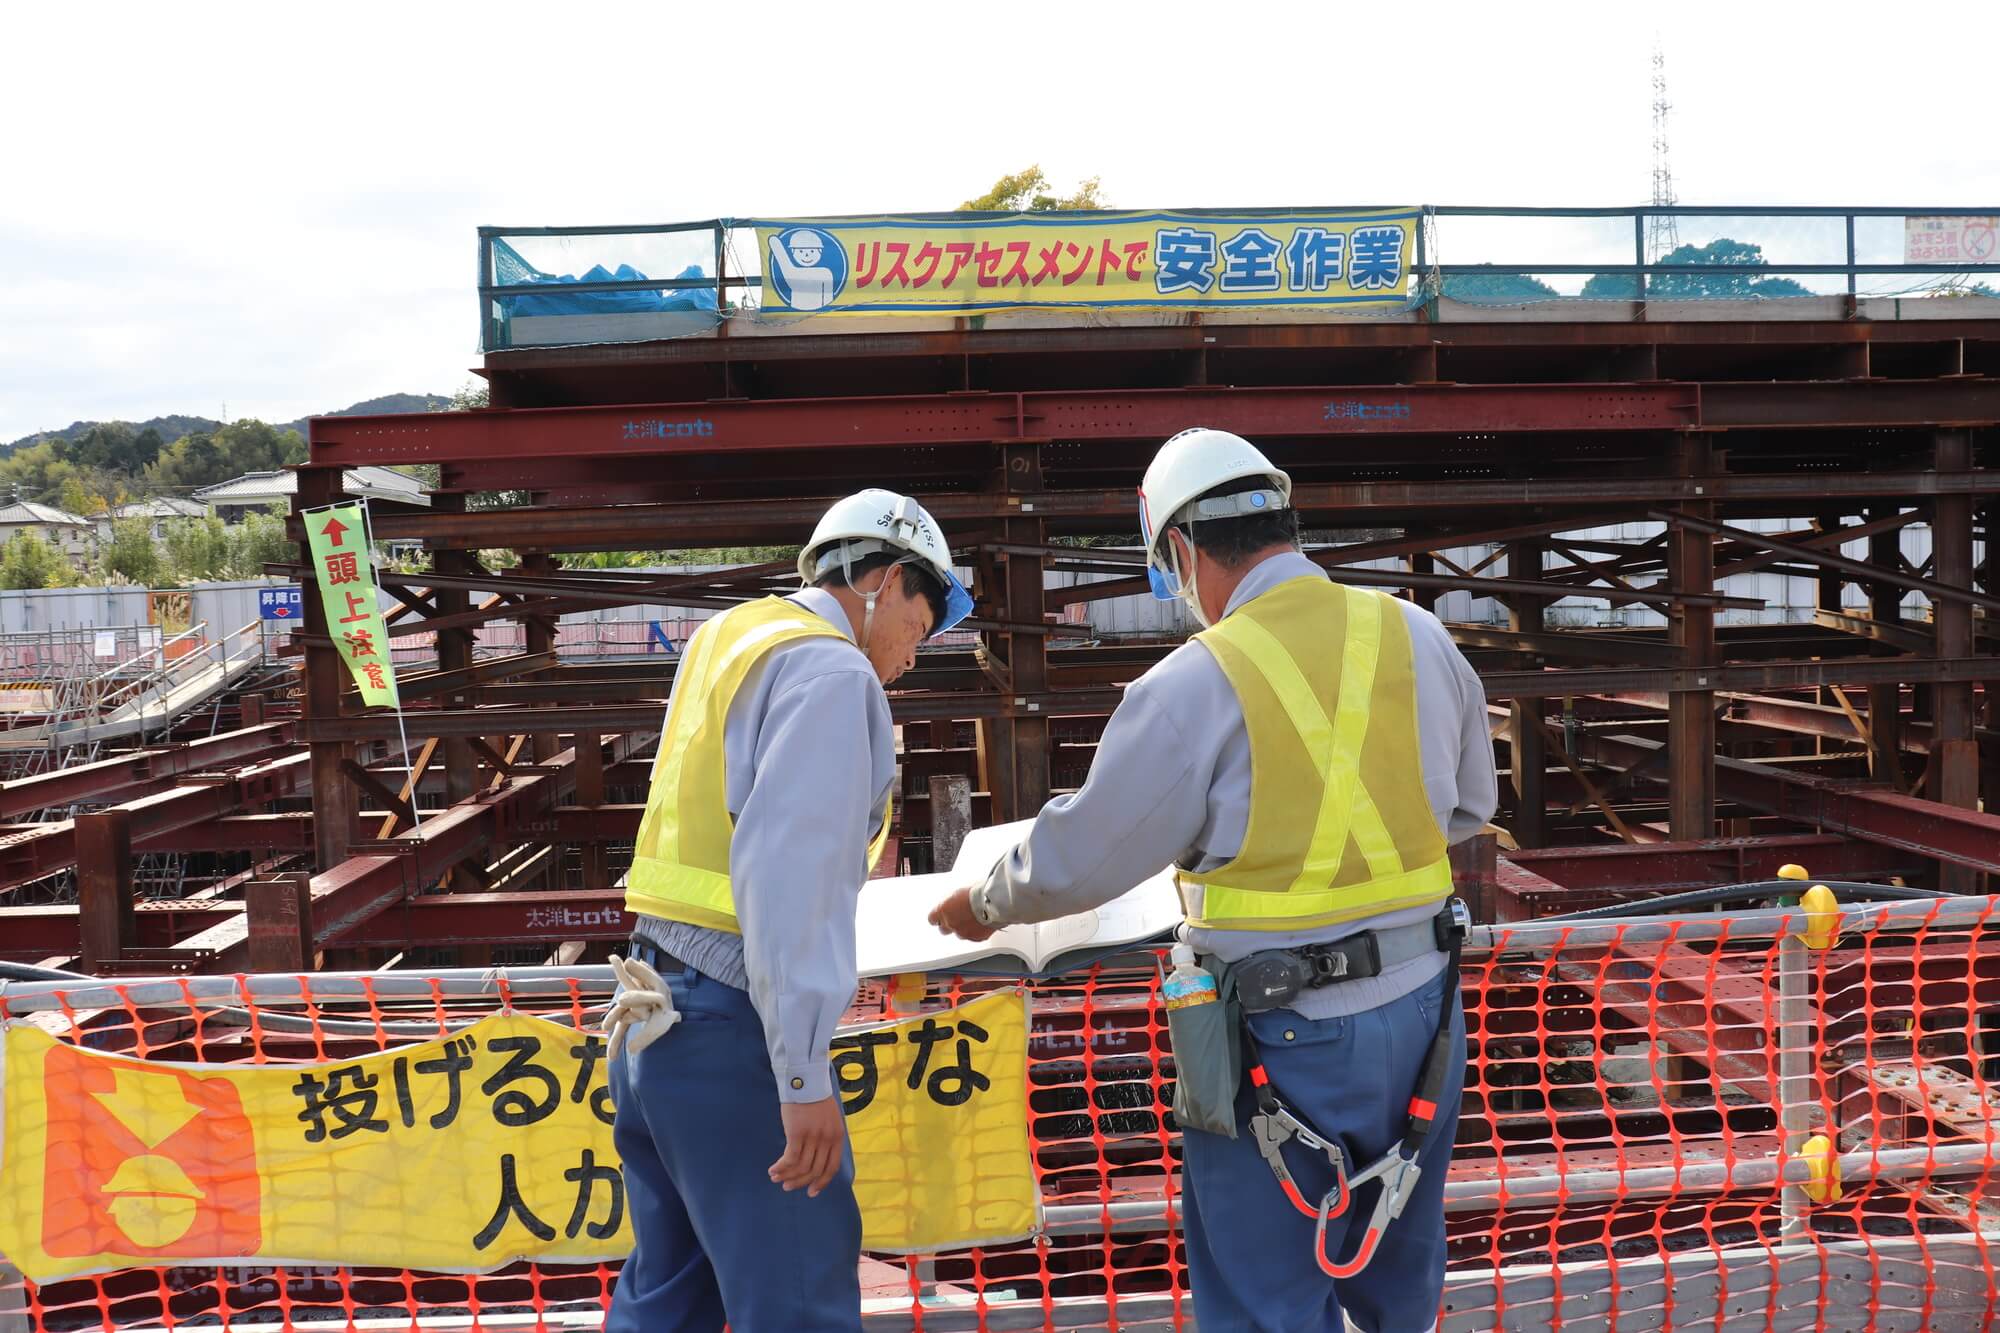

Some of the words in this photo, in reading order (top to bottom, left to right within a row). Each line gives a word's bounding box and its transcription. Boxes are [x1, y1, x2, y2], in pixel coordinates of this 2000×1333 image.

[855, 239, 1149, 289] リスクアセスメントで
[1155, 225, 1404, 294] 安全作業
[262, 591, 302, 605] 昇降口
[325, 552, 387, 689] 頭上注意
